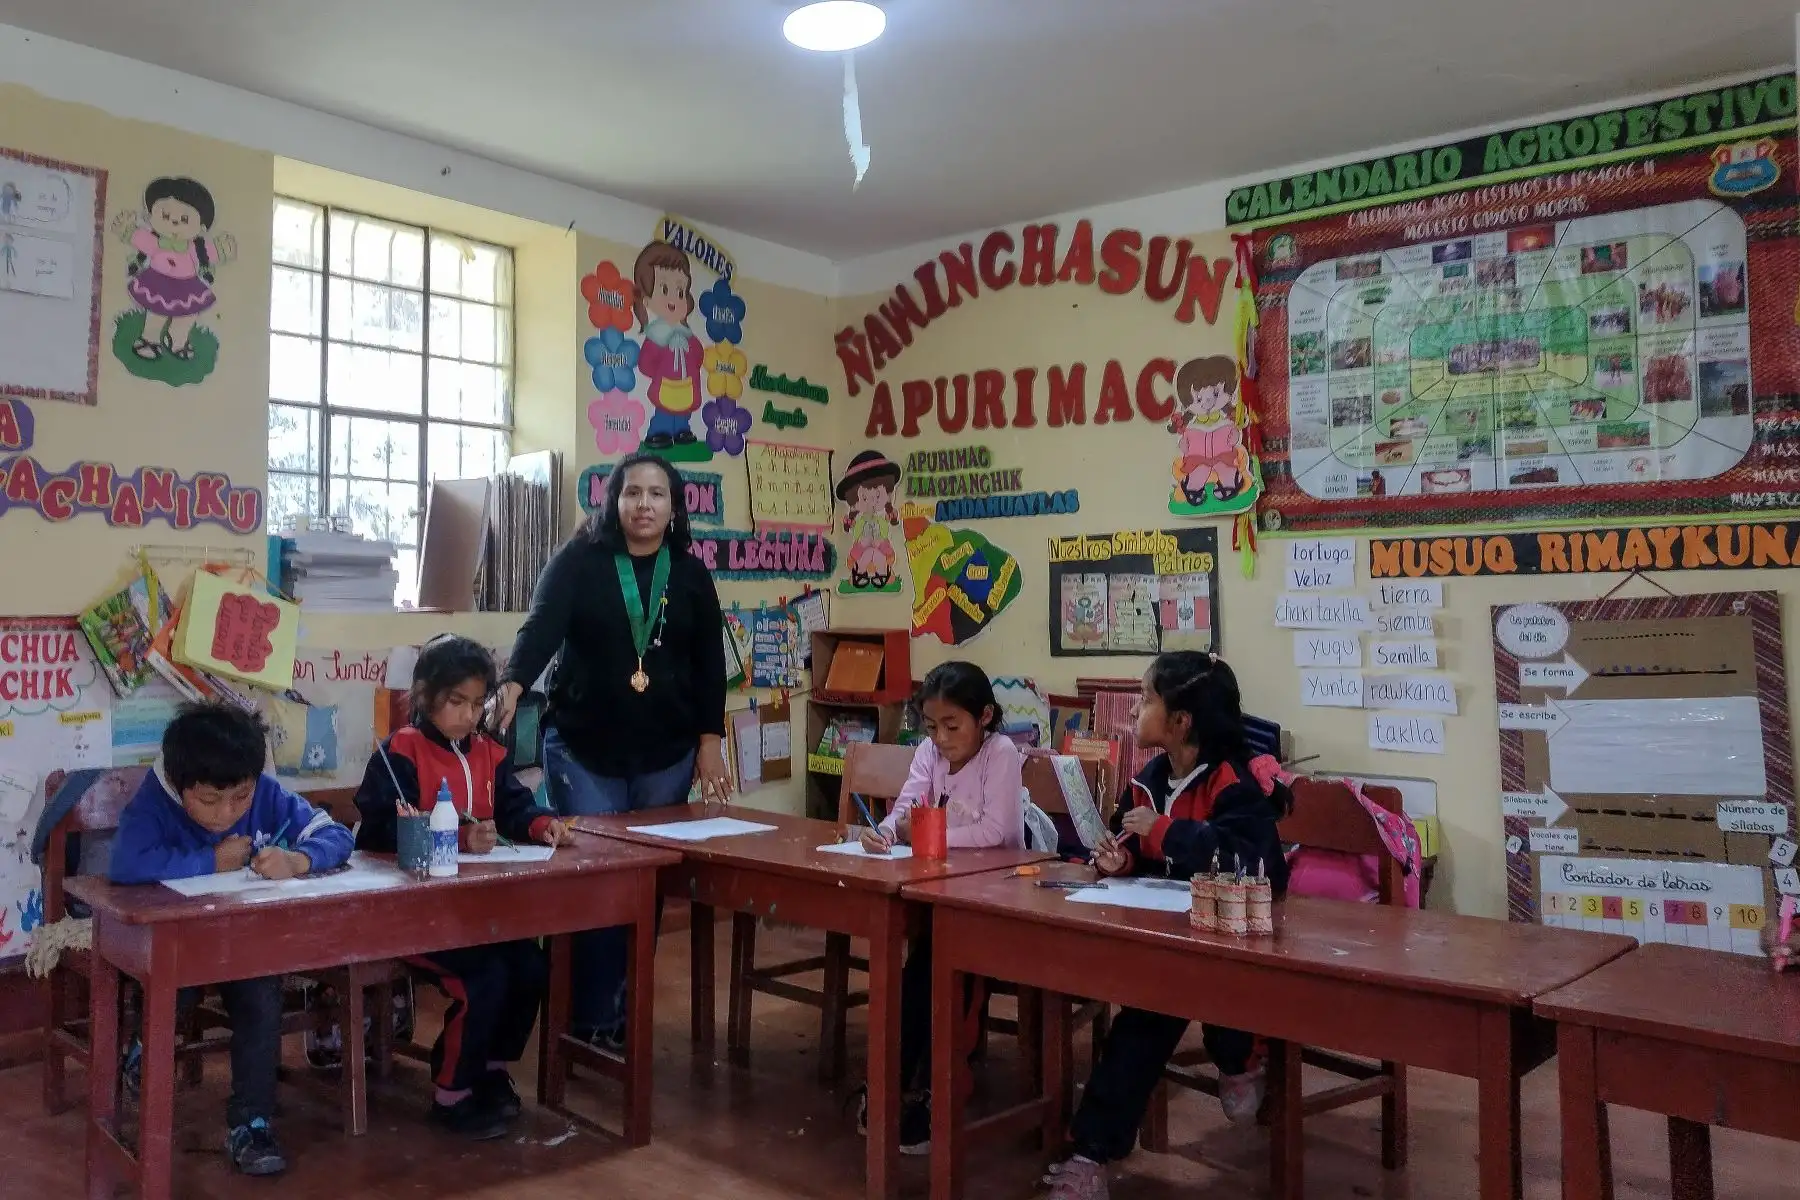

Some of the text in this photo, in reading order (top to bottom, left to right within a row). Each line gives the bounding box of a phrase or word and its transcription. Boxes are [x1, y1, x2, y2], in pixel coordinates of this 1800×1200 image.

[1227, 76, 1797, 222] CALENDARIO AGROFESTIVO
[664, 218, 734, 282] VALORES
[835, 219, 1234, 397] ÑAWINCHASUN
[866, 357, 1179, 438] APURIMAC
[907, 447, 991, 472] APURIMAC
[0, 456, 258, 533] ACHANIKU
[937, 490, 1079, 521] ANDAHUAYLAS
[729, 540, 827, 576] LECTURA
[1049, 537, 1112, 562] Nuestros
[1293, 541, 1352, 565] tortuga
[1371, 536, 1516, 578] MUSUQ
[1293, 567, 1332, 588] Veloz
[1379, 584, 1432, 605] tierra
[1524, 664, 1574, 678] Se forma
[1369, 680, 1450, 704] rawkana
[1500, 708, 1557, 721] Se escribe
[1374, 715, 1439, 745] taklla
[1534, 798, 1548, 808] que
[1717, 803, 1787, 817] Número de
[1530, 832, 1578, 842] Vocales que
[1776, 843, 1790, 858] 5
[1562, 863, 1713, 893] Contador de letras
[1782, 872, 1793, 888] 4
[1568, 896, 1577, 912] 2
[1587, 898, 1597, 913] 3
[1629, 900, 1638, 916] 5
[1649, 903, 1659, 917] 6
[1691, 904, 1701, 920] 8
[1713, 907, 1722, 921] 9
[1737, 907, 1758, 924] 10
